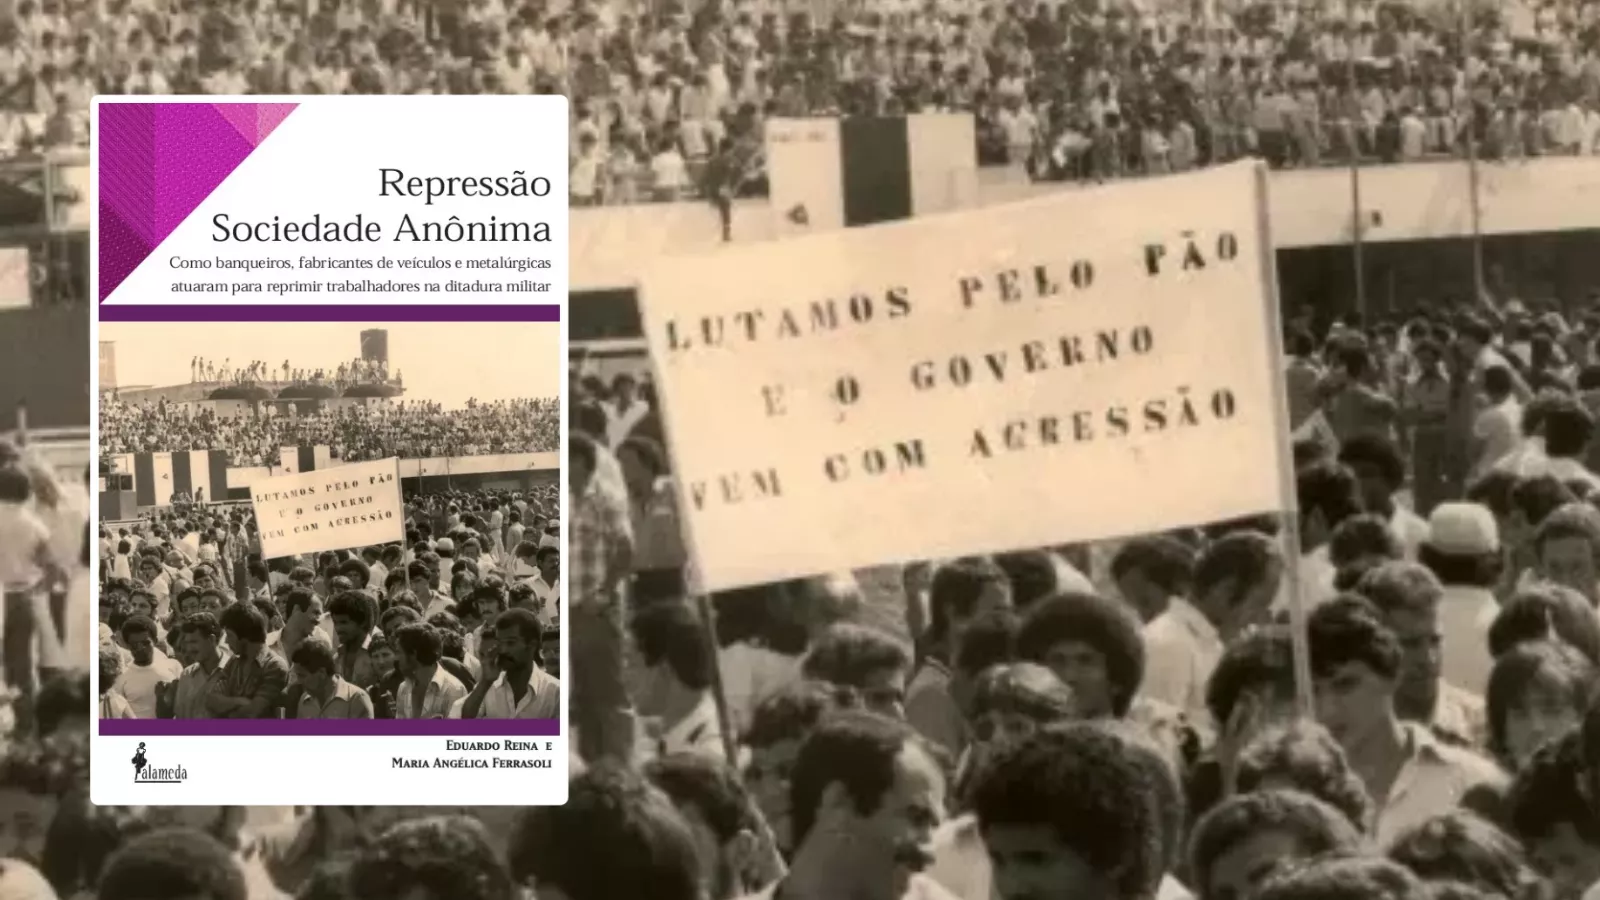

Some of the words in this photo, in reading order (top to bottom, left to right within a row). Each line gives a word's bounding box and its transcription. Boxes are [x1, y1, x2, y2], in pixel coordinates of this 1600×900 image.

[665, 286, 912, 351] LUTAMOS
[958, 259, 1095, 308] PELO
[1143, 229, 1239, 277] PÃO
[761, 384, 787, 418] E
[835, 375, 860, 406] O
[910, 325, 1154, 391] GOVERNO
[256, 486, 315, 503] LUTAMOS
[325, 480, 359, 493] PELO
[369, 473, 393, 485] PÃO
[691, 468, 782, 512] VEM
[823, 439, 925, 482] COM
